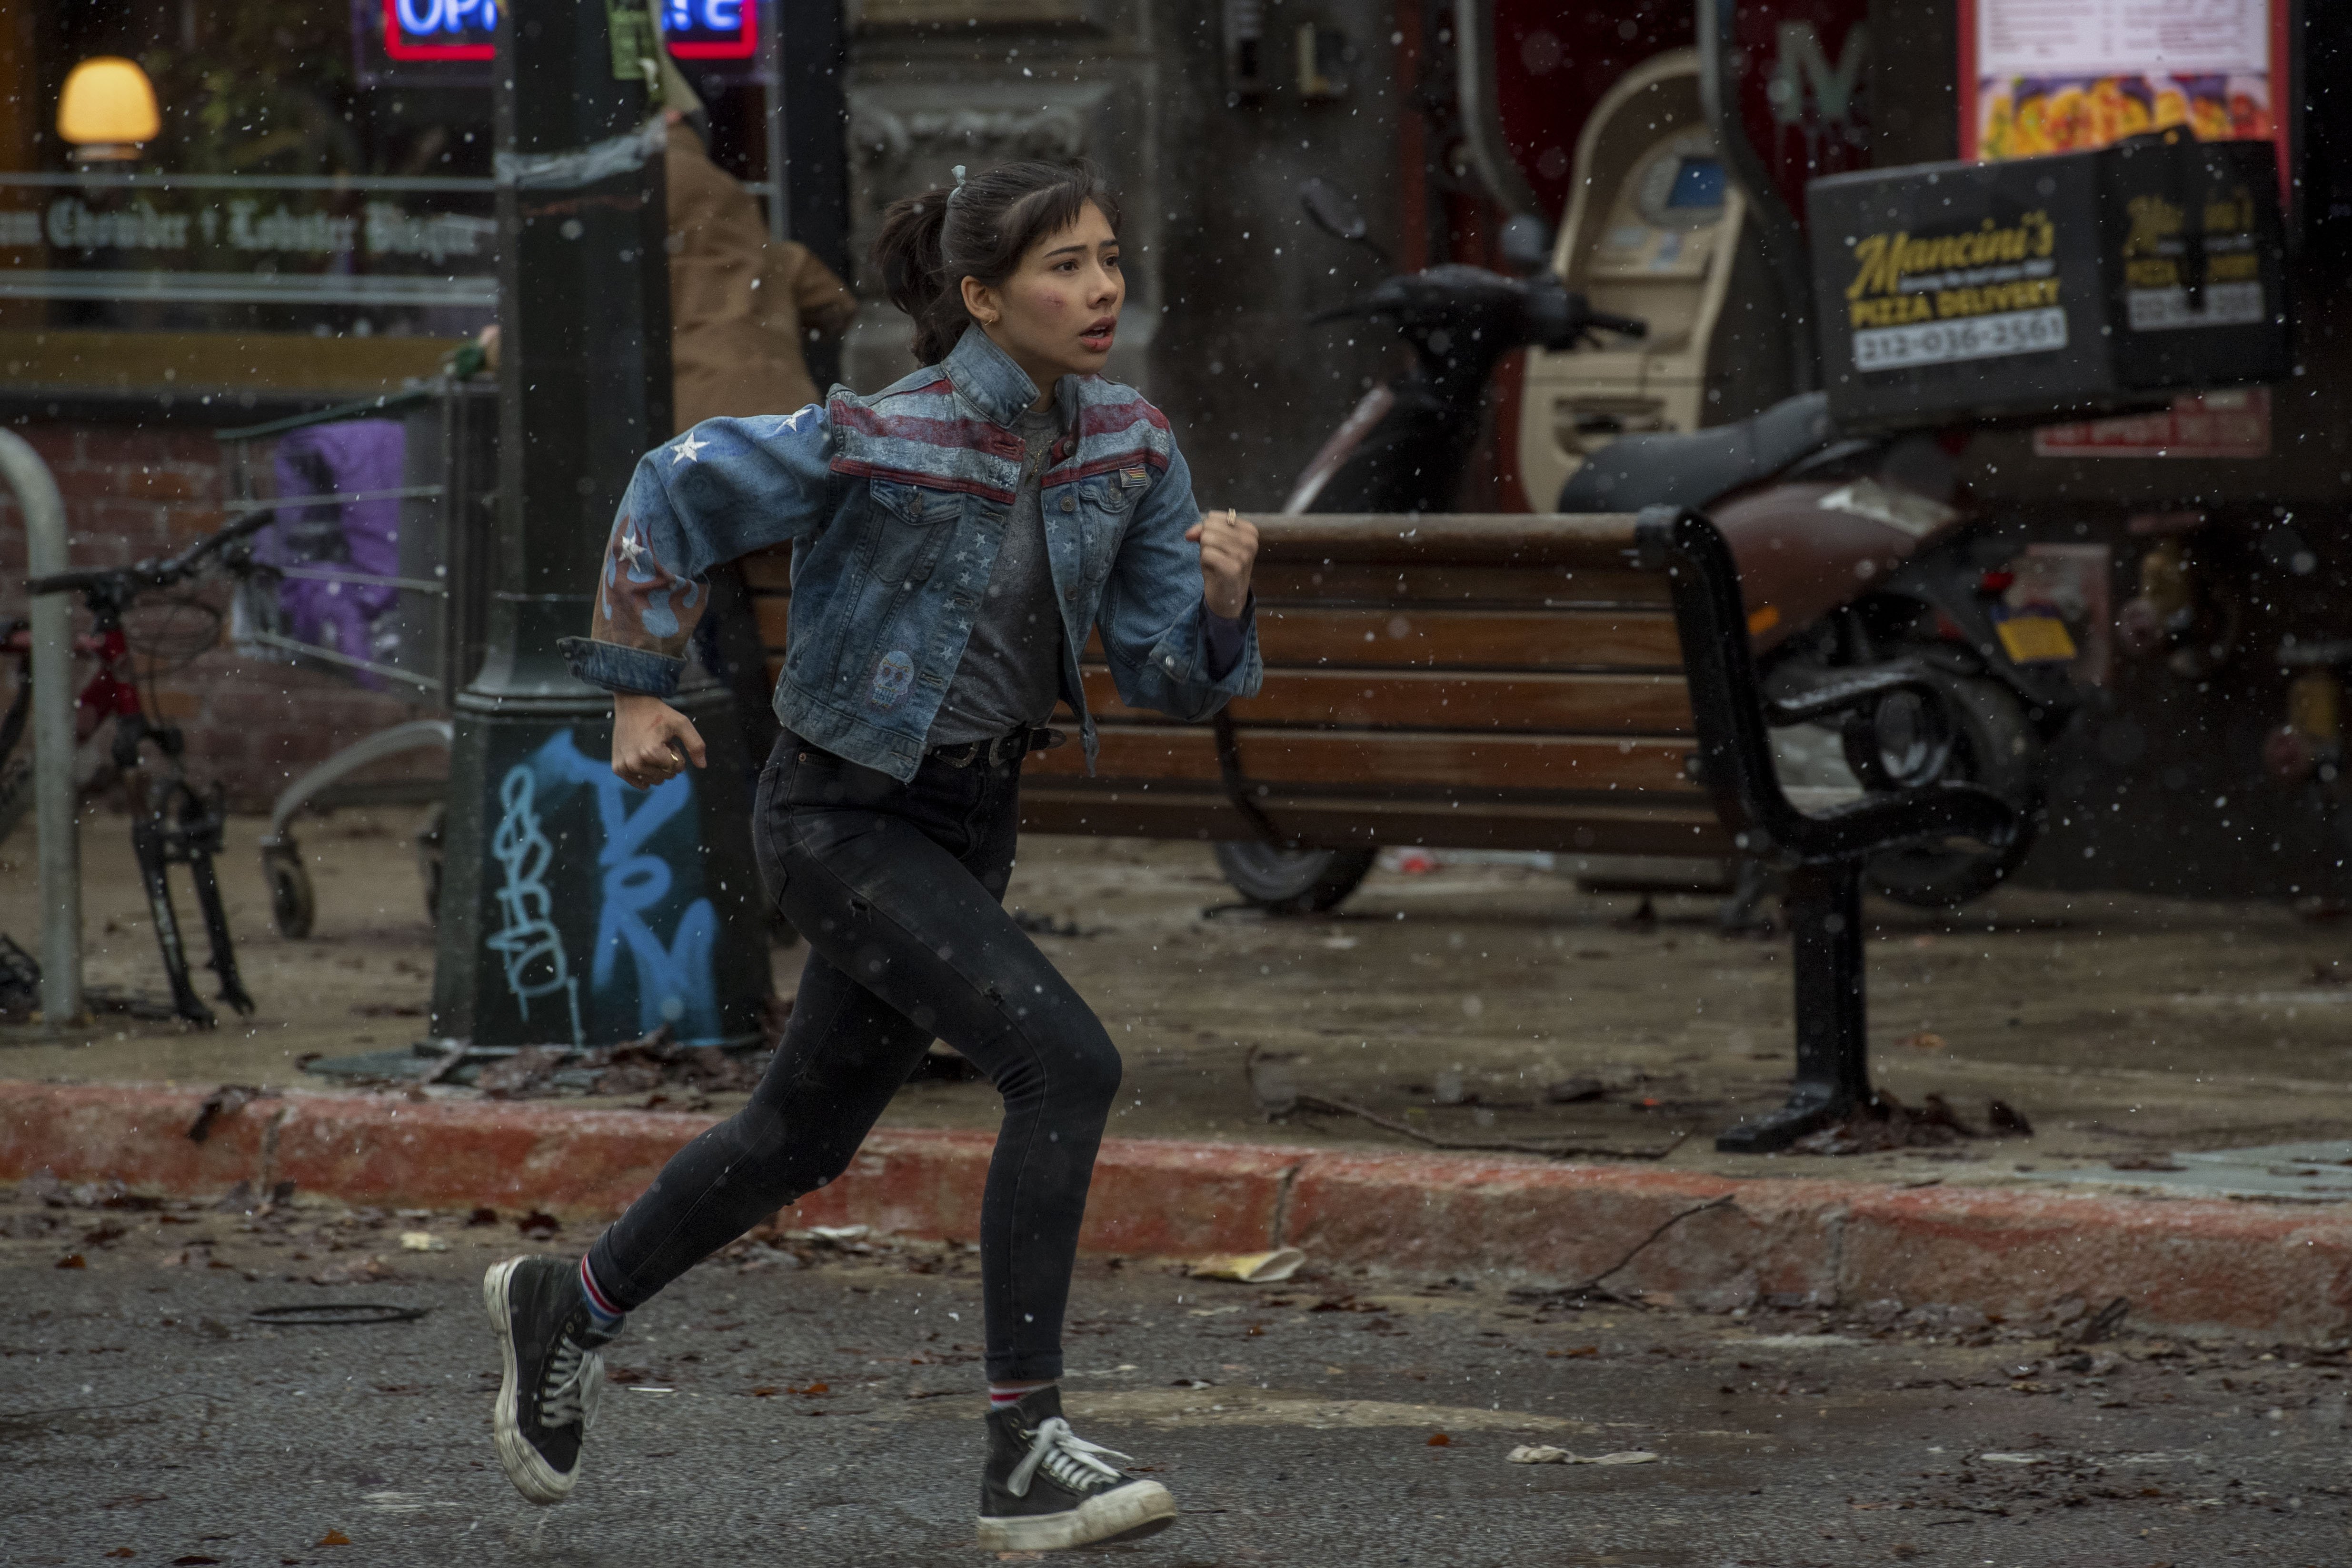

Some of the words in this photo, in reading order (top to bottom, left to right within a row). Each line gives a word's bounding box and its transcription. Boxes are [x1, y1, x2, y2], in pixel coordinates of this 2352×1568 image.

[1845, 209, 2055, 300] Mancini's
[1850, 292, 1933, 329] PIZZA
[1936, 279, 2060, 318] DELIVERY
